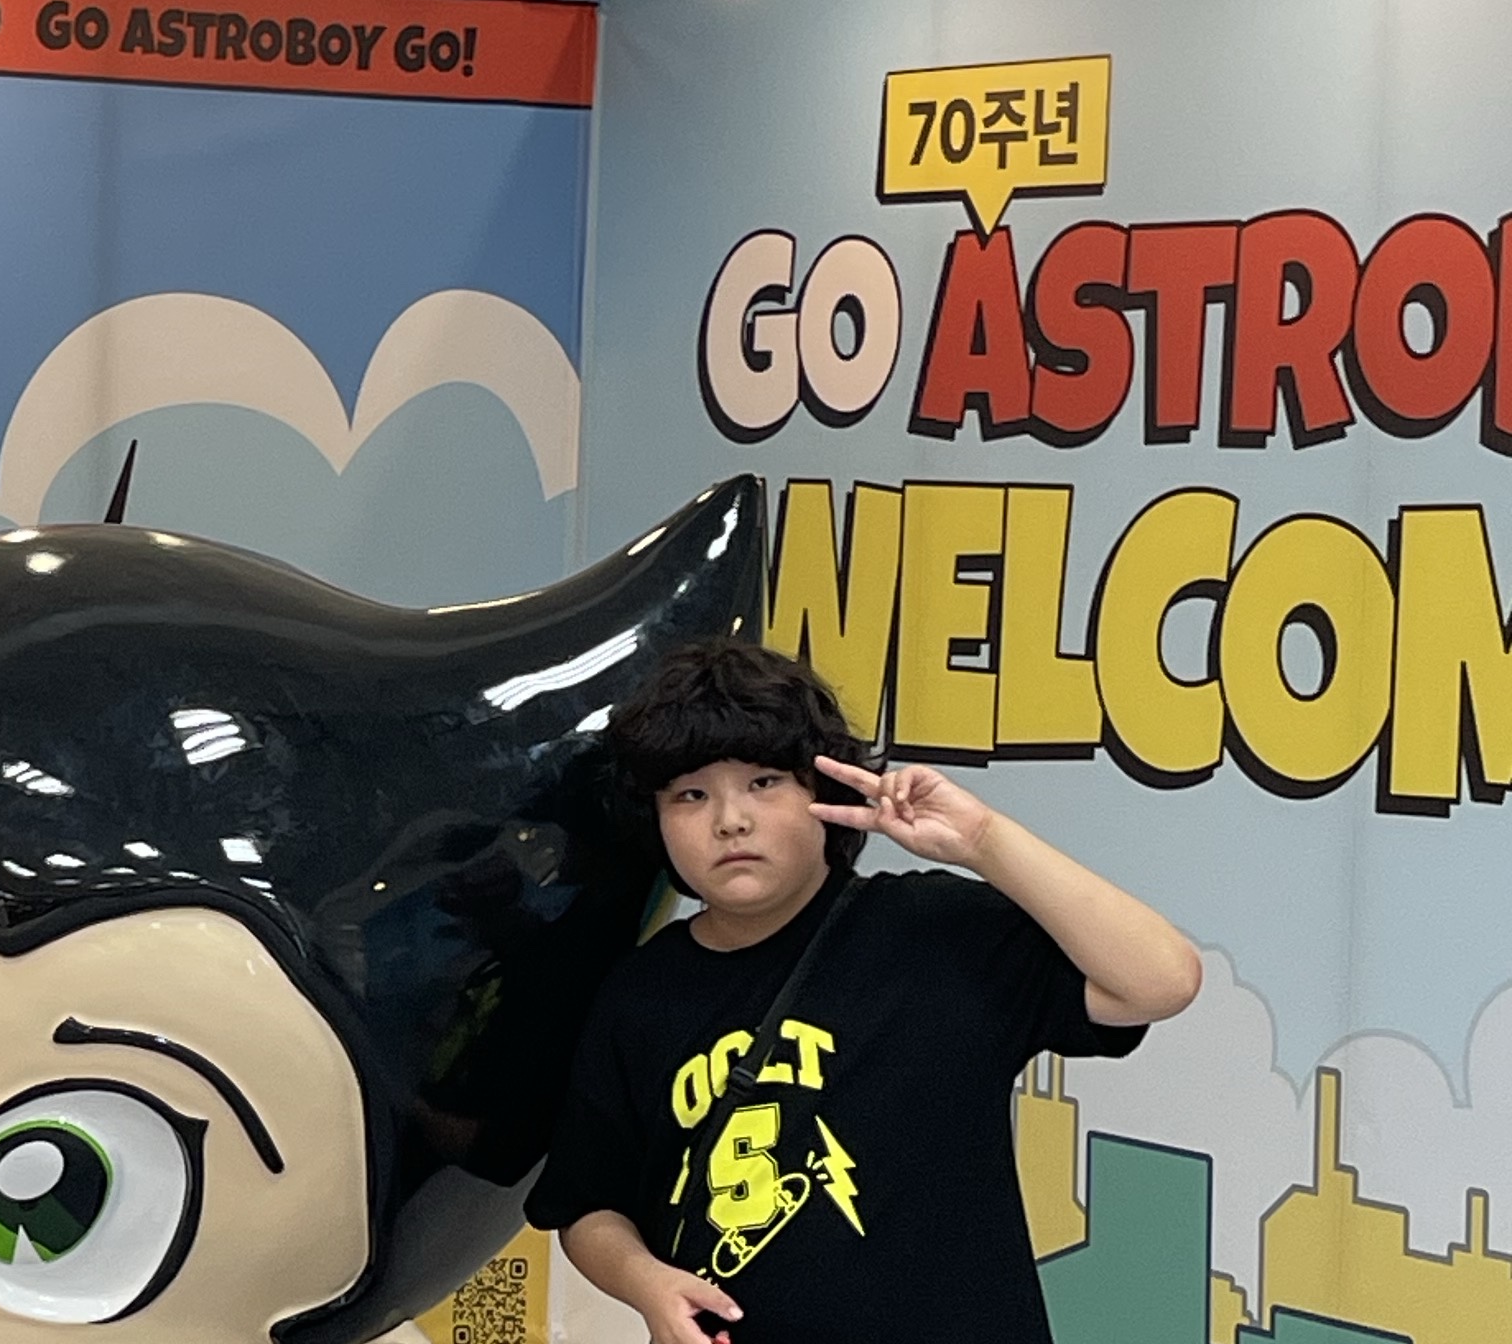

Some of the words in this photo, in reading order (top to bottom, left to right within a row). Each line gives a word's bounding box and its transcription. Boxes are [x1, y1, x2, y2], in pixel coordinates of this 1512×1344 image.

[36, 0, 110, 50] GO
[120, 7, 386, 71] ASTROBOY
[394, 25, 478, 78] GO!
[908, 81, 1079, 169] 70주년
[698, 228, 902, 444] GO
[908, 210, 1512, 456] ASTRO
